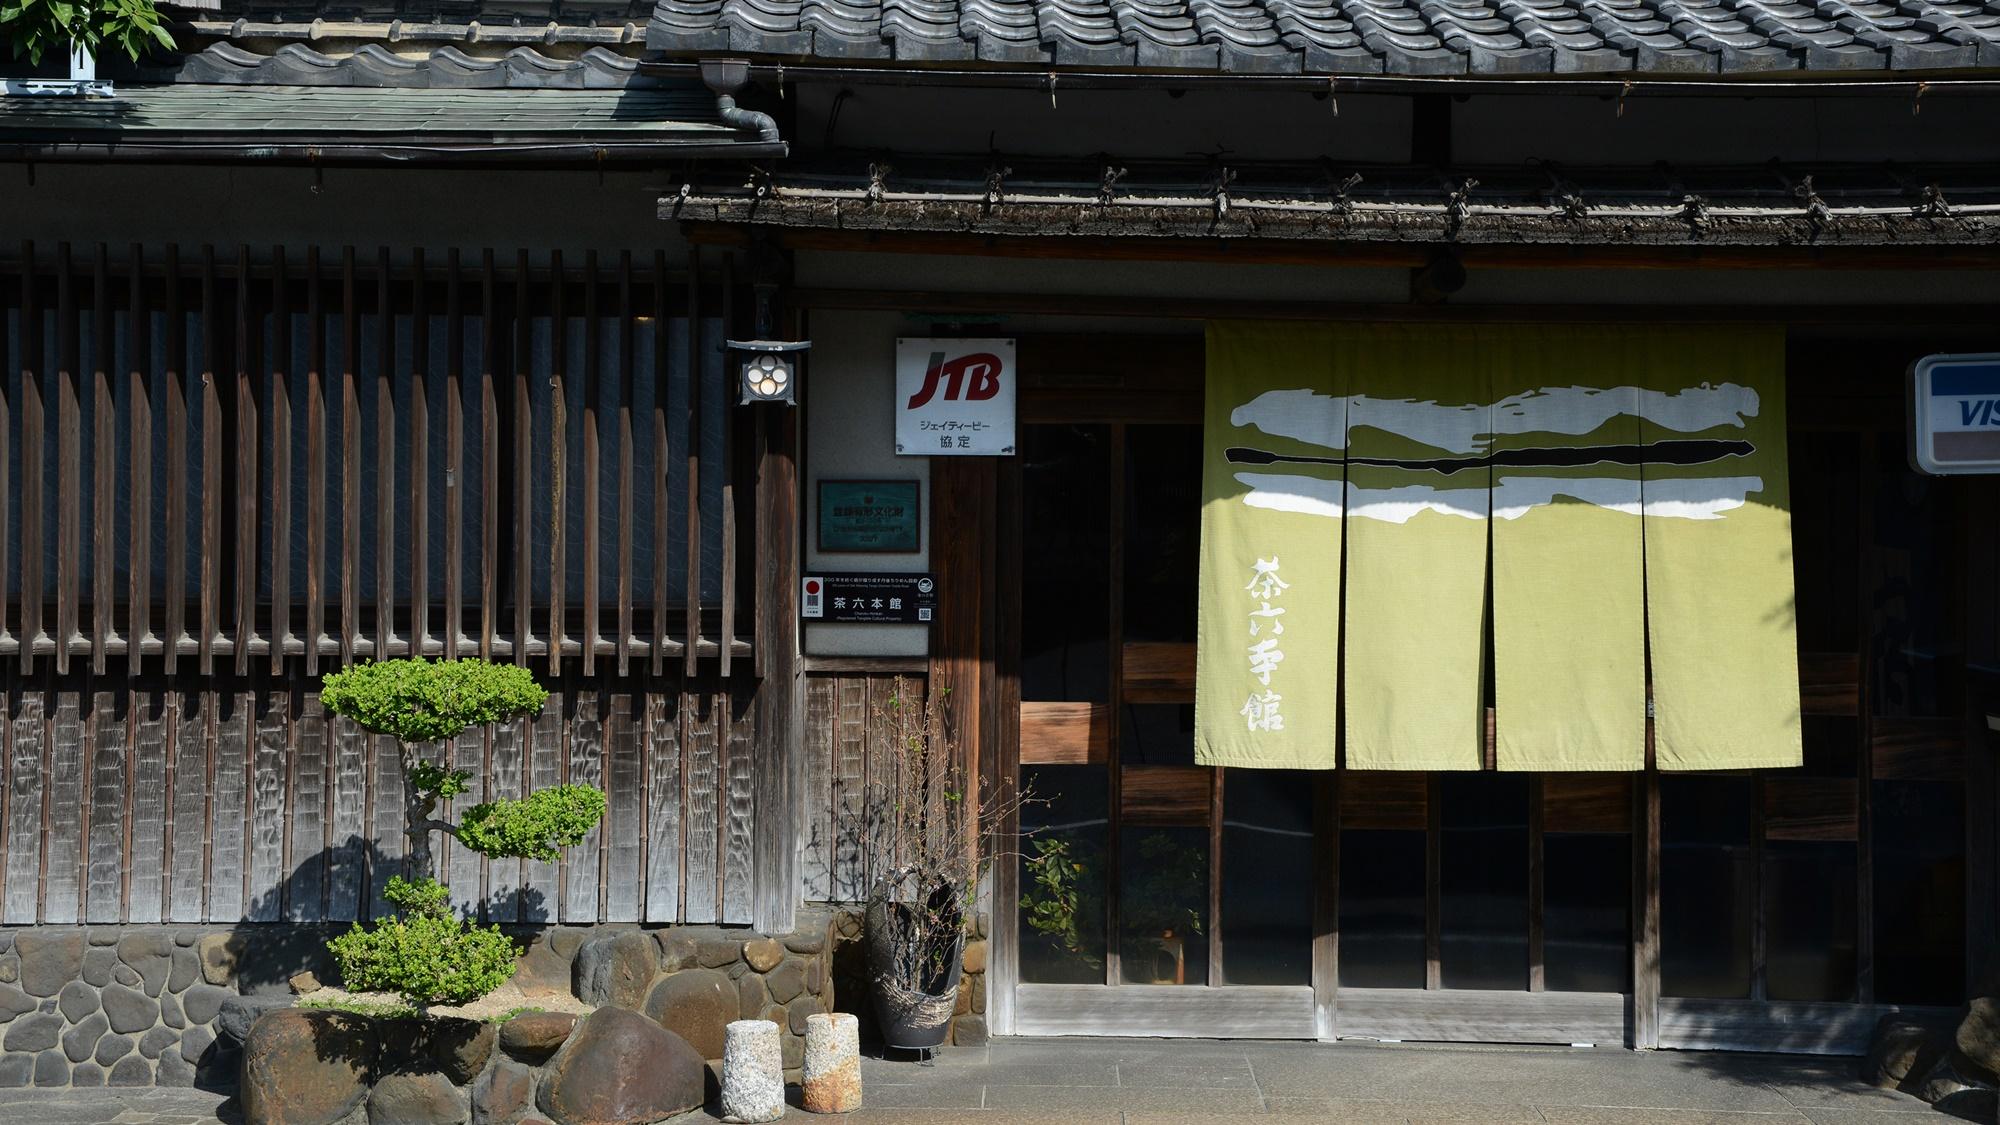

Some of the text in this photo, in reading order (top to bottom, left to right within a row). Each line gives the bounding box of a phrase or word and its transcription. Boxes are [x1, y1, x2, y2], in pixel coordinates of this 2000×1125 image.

[907, 352, 1003, 410] JTB
[920, 420, 991, 431] ジェイティービー
[940, 435, 971, 448] 協定
[834, 597, 902, 610] 茶六本館
